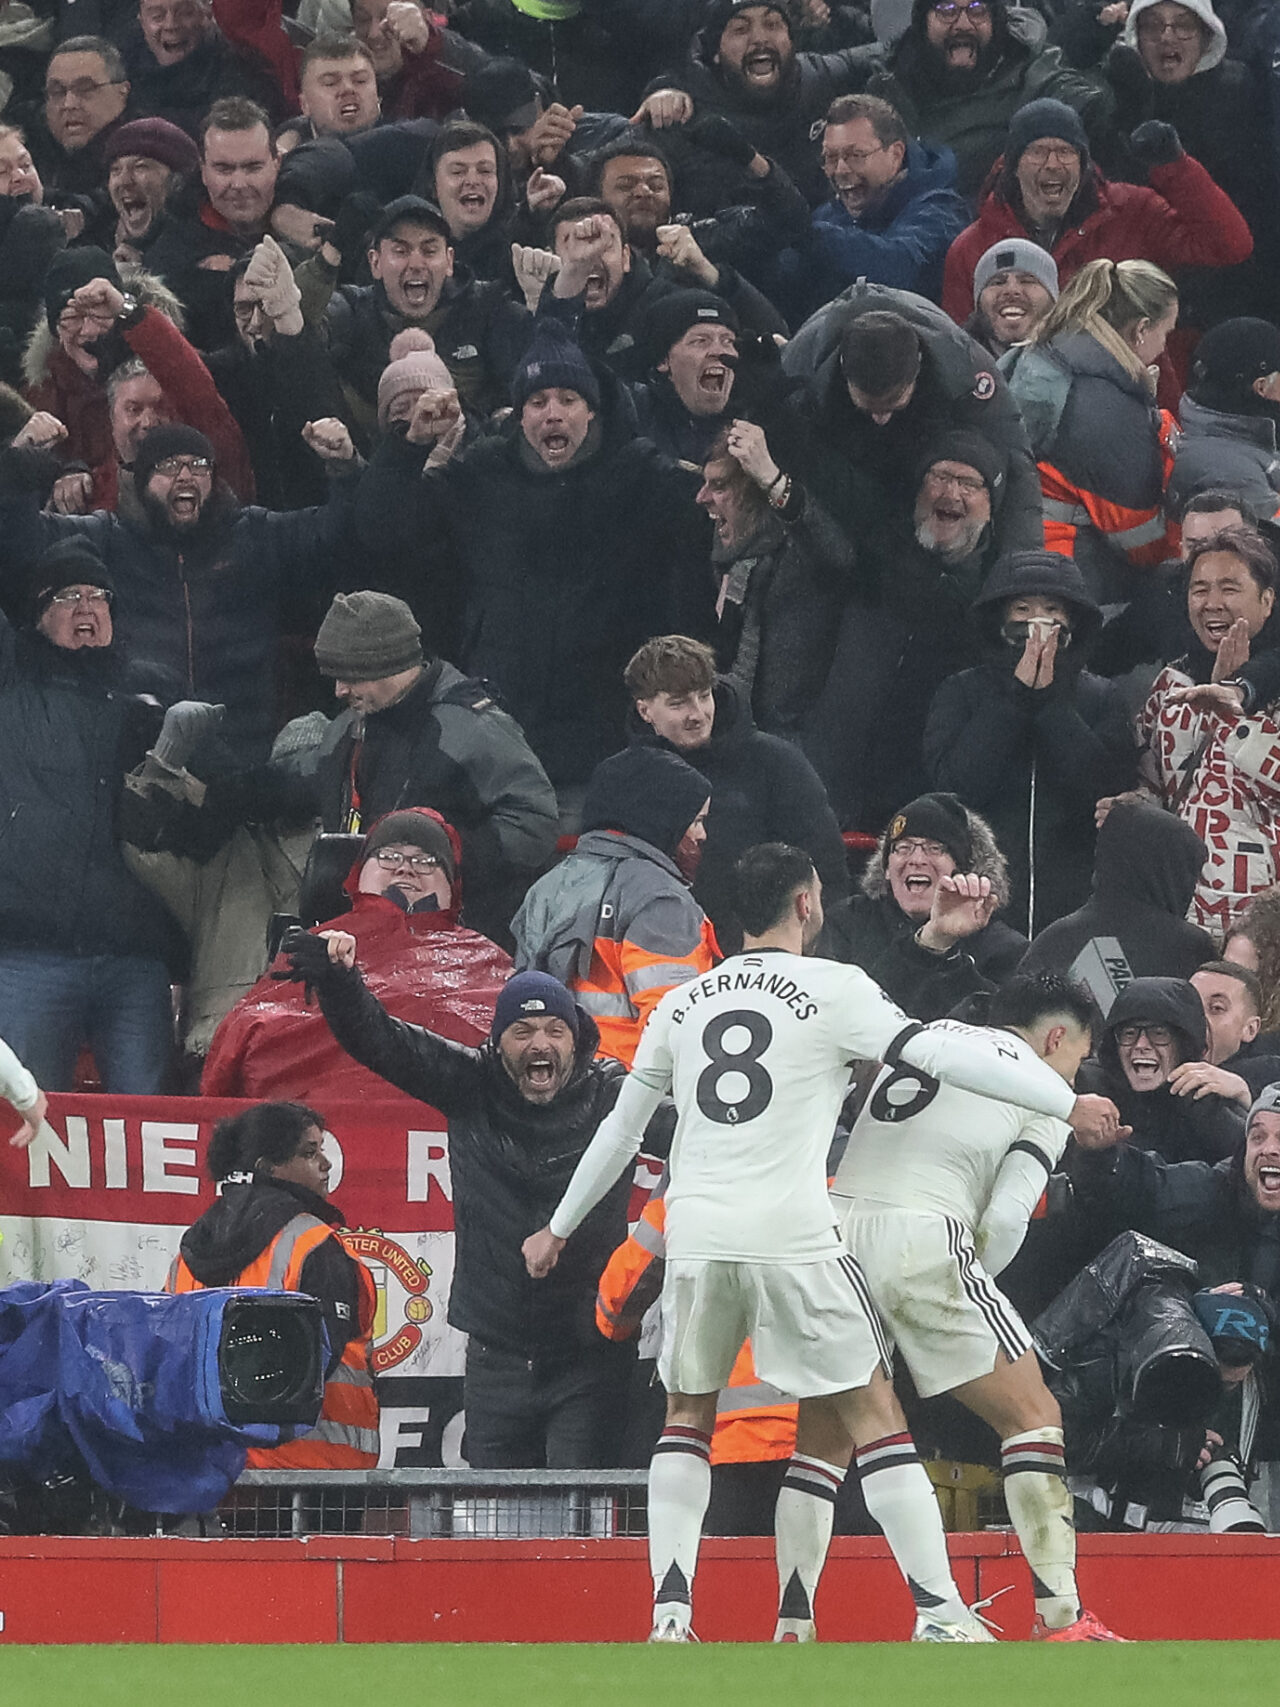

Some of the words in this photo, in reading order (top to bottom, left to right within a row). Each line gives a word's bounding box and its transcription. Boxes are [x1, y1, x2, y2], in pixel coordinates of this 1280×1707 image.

[672, 1005, 691, 1025] B.
[688, 972, 818, 1021] FERNANDES
[696, 1008, 774, 1125] 8
[381, 1245, 421, 1287] UNITED
[376, 1335, 412, 1365] CLUB
